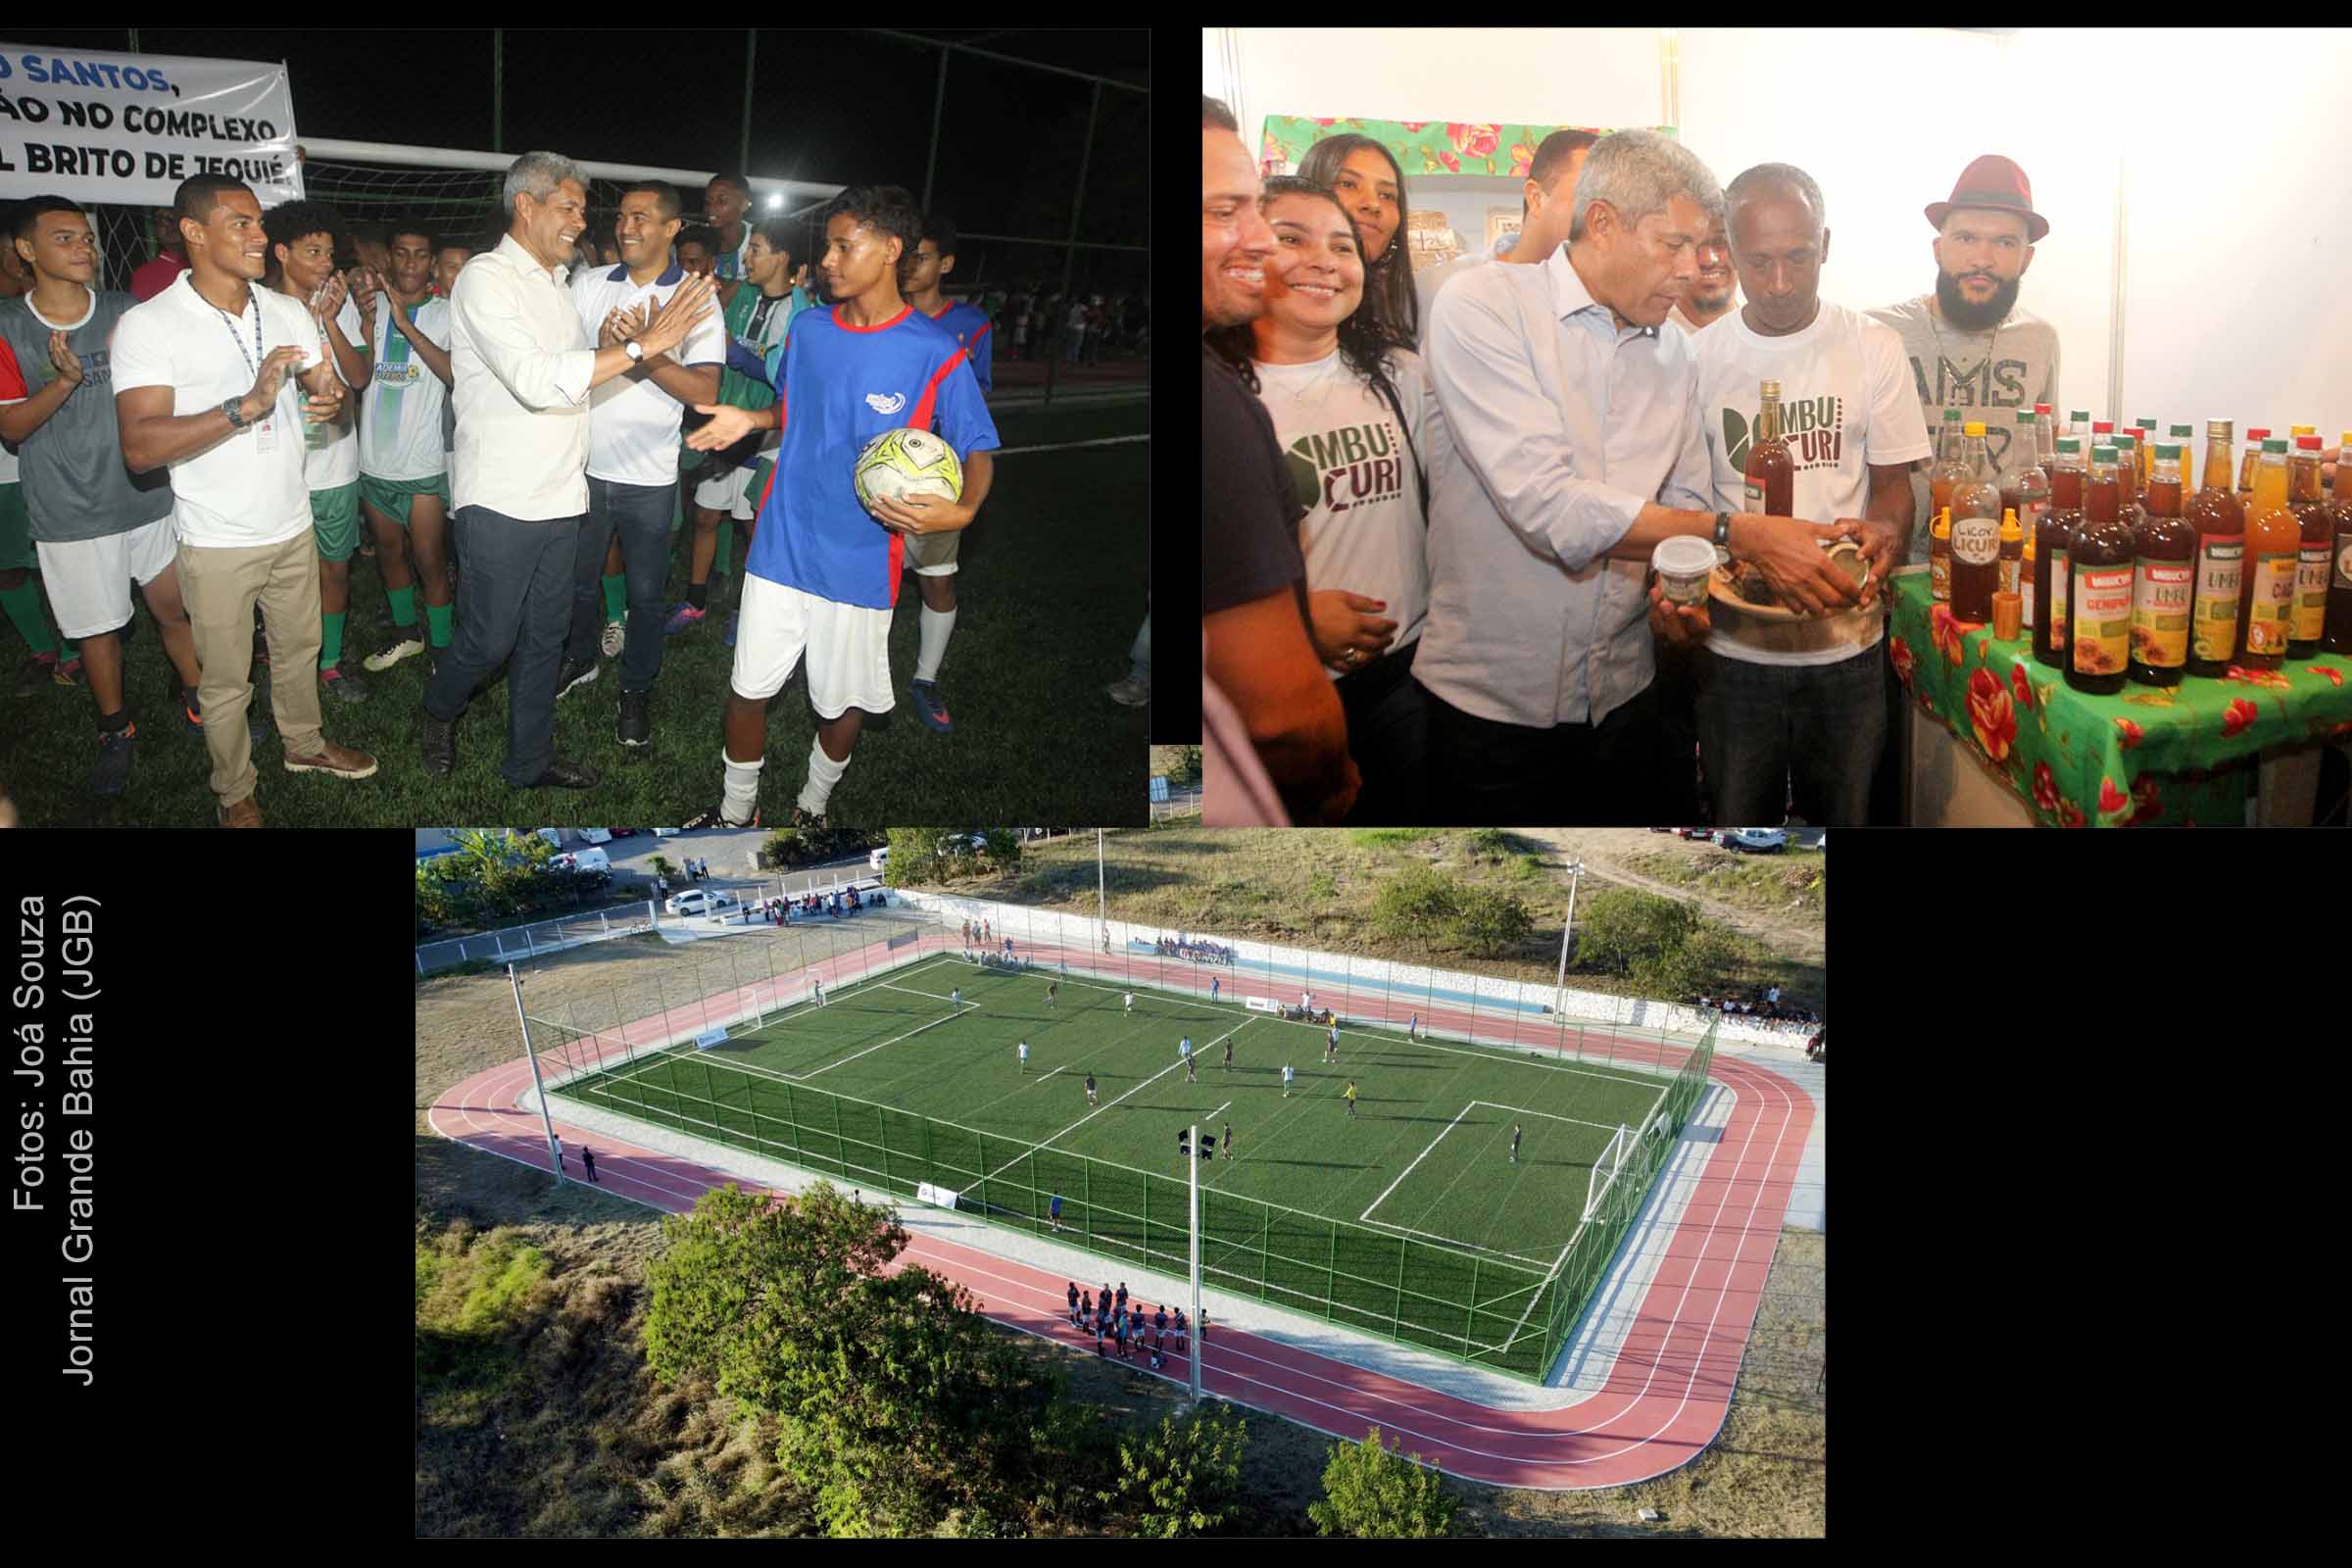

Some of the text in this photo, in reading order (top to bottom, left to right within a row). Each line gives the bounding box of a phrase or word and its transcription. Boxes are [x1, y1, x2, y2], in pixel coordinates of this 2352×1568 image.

[22, 55, 180, 97] SANTOS,
[57, 101, 114, 129] NO
[123, 106, 277, 142] COMPLEXO
[24, 142, 135, 178] BRITO
[145, 151, 186, 180] DE
